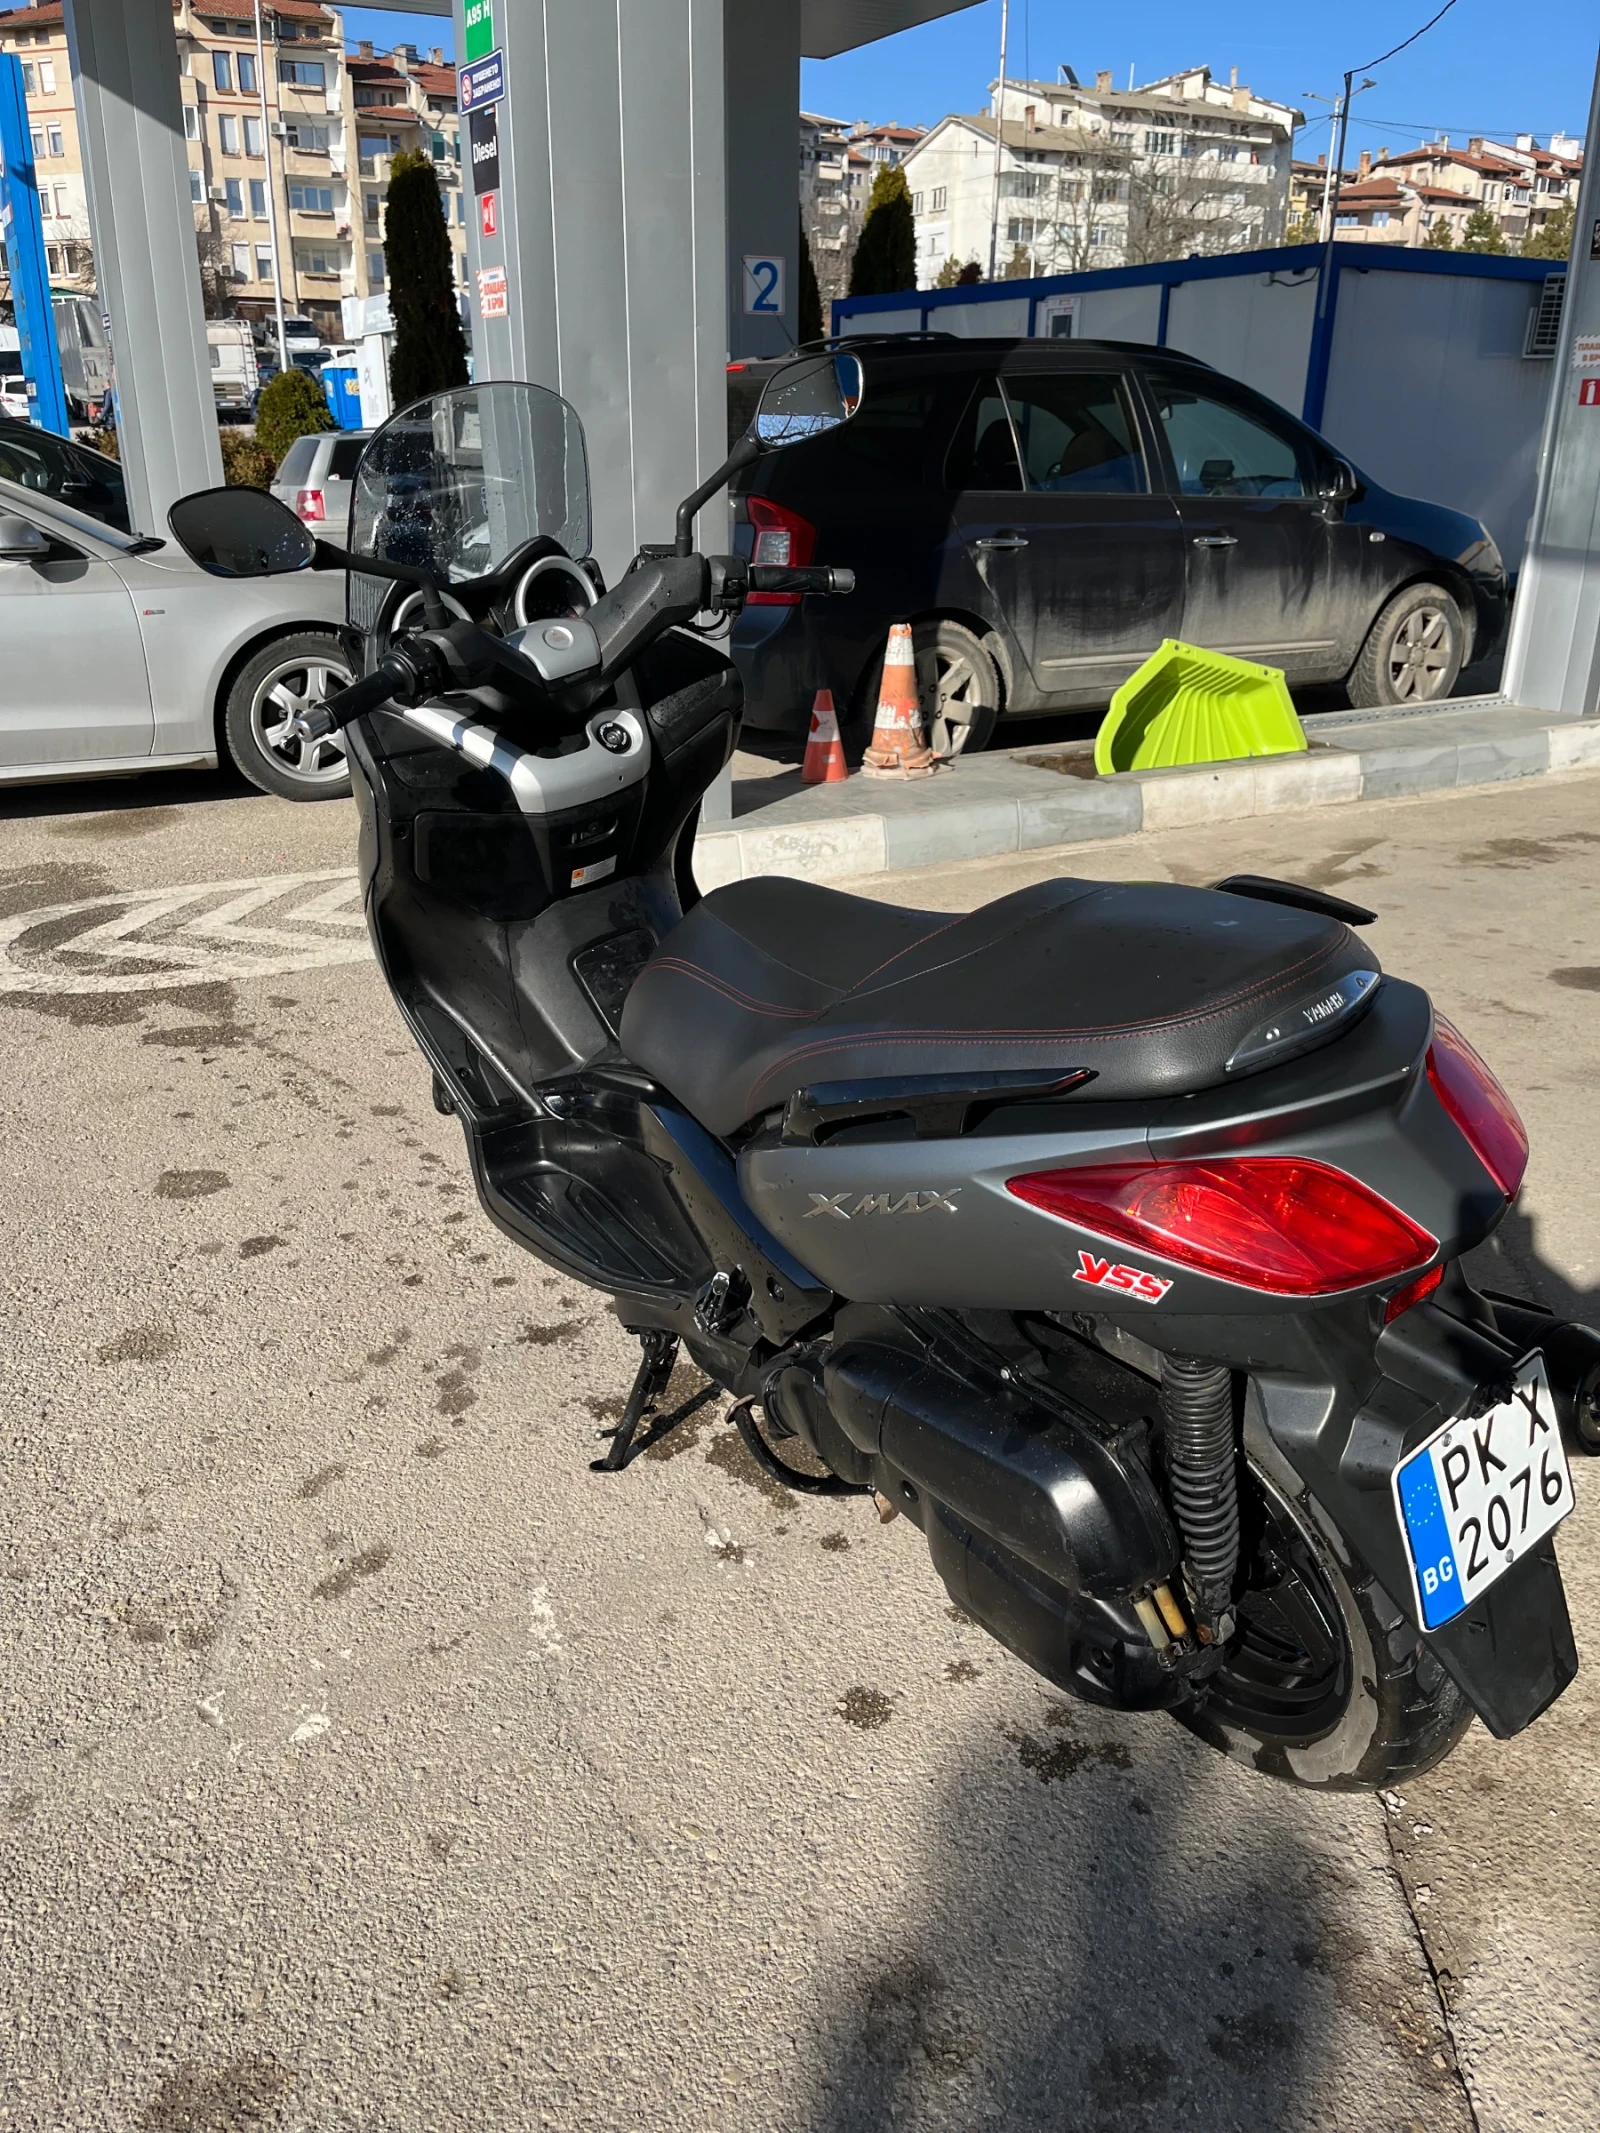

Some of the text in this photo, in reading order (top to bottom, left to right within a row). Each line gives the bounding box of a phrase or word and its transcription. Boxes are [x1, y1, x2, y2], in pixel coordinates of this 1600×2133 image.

[472, 135, 497, 164] Diesel
[753, 261, 779, 311] 2
[1073, 1250, 1172, 1299] YSS
[1442, 1375, 1550, 1513] PK X
[1459, 1448, 1563, 1582] 2076
[1422, 1555, 1454, 1596] BG
